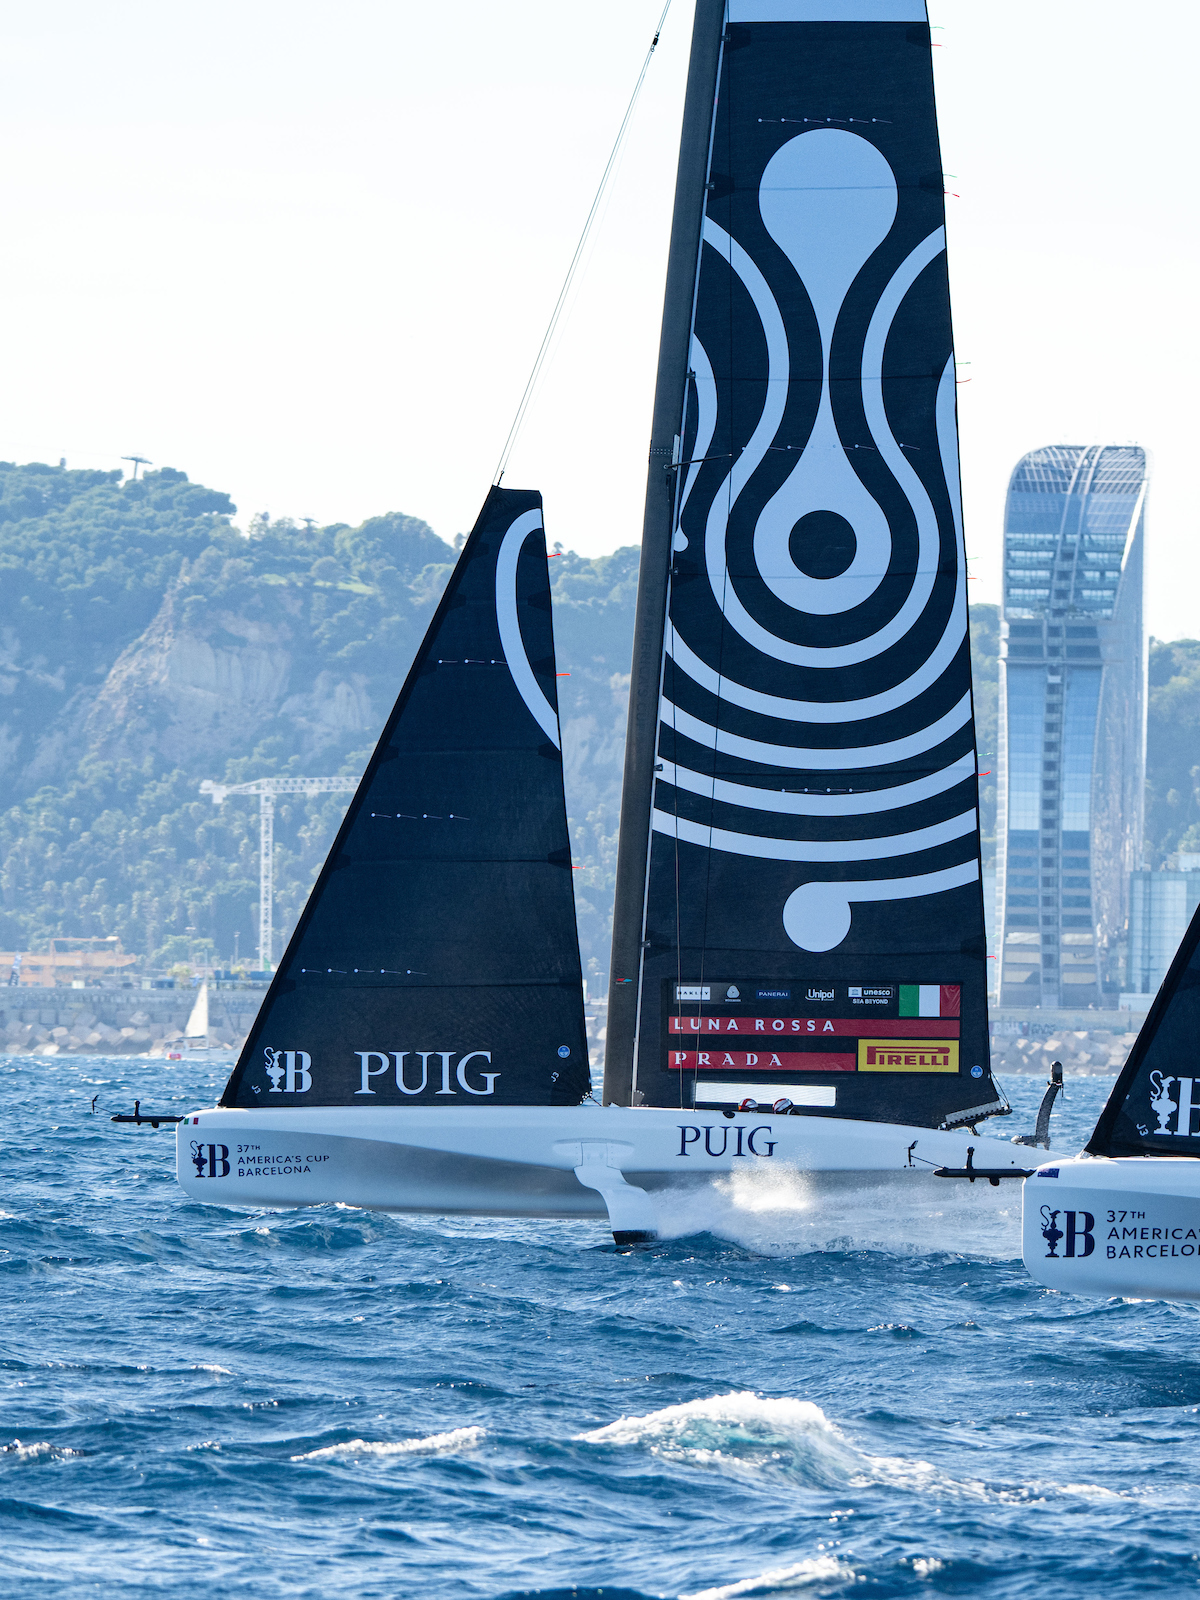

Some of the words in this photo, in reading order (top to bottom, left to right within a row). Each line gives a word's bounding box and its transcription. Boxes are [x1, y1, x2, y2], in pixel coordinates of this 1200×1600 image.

[808, 988, 835, 1001] Unipol
[674, 1018, 739, 1031] LUNA
[755, 1019, 835, 1032] ROSSA
[674, 1052, 782, 1066] PRADA
[866, 1046, 950, 1066] PIRELLI
[354, 1050, 501, 1095] PUIG
[1136, 1123, 1149, 1136] J3
[676, 1125, 779, 1157] PUIG
[237, 1144, 261, 1153] 37TH
[237, 1155, 302, 1165] AMERICA'S
[306, 1155, 330, 1163] CUP
[238, 1165, 311, 1177] BARCELONA
[1106, 1210, 1145, 1223] 37TH
